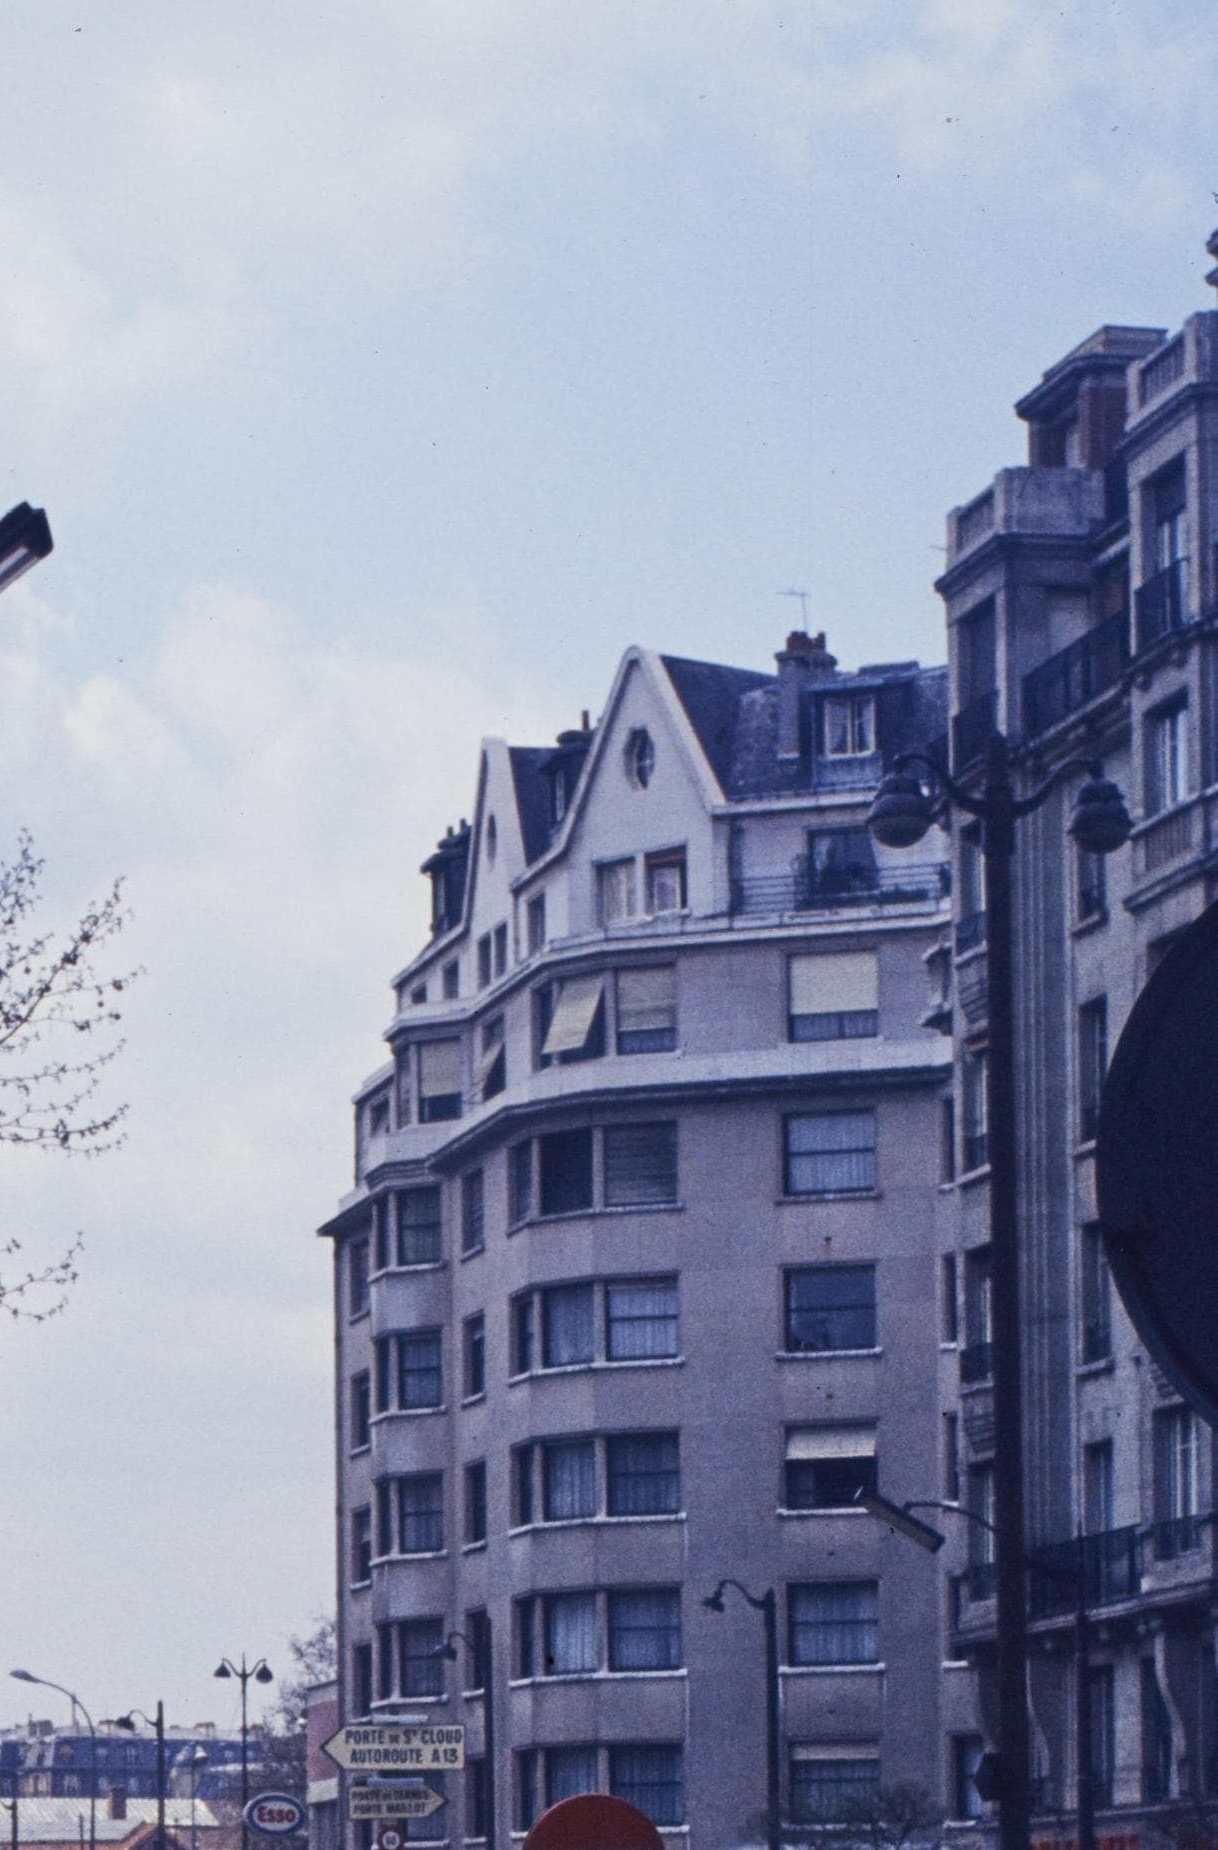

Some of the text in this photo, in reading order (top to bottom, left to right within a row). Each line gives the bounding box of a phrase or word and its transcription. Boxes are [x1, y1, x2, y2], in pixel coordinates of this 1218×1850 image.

[345, 1729, 385, 1744] PORTE
[422, 1729, 462, 1744] CLOUD
[350, 1749, 423, 1763] AUTOROUTE
